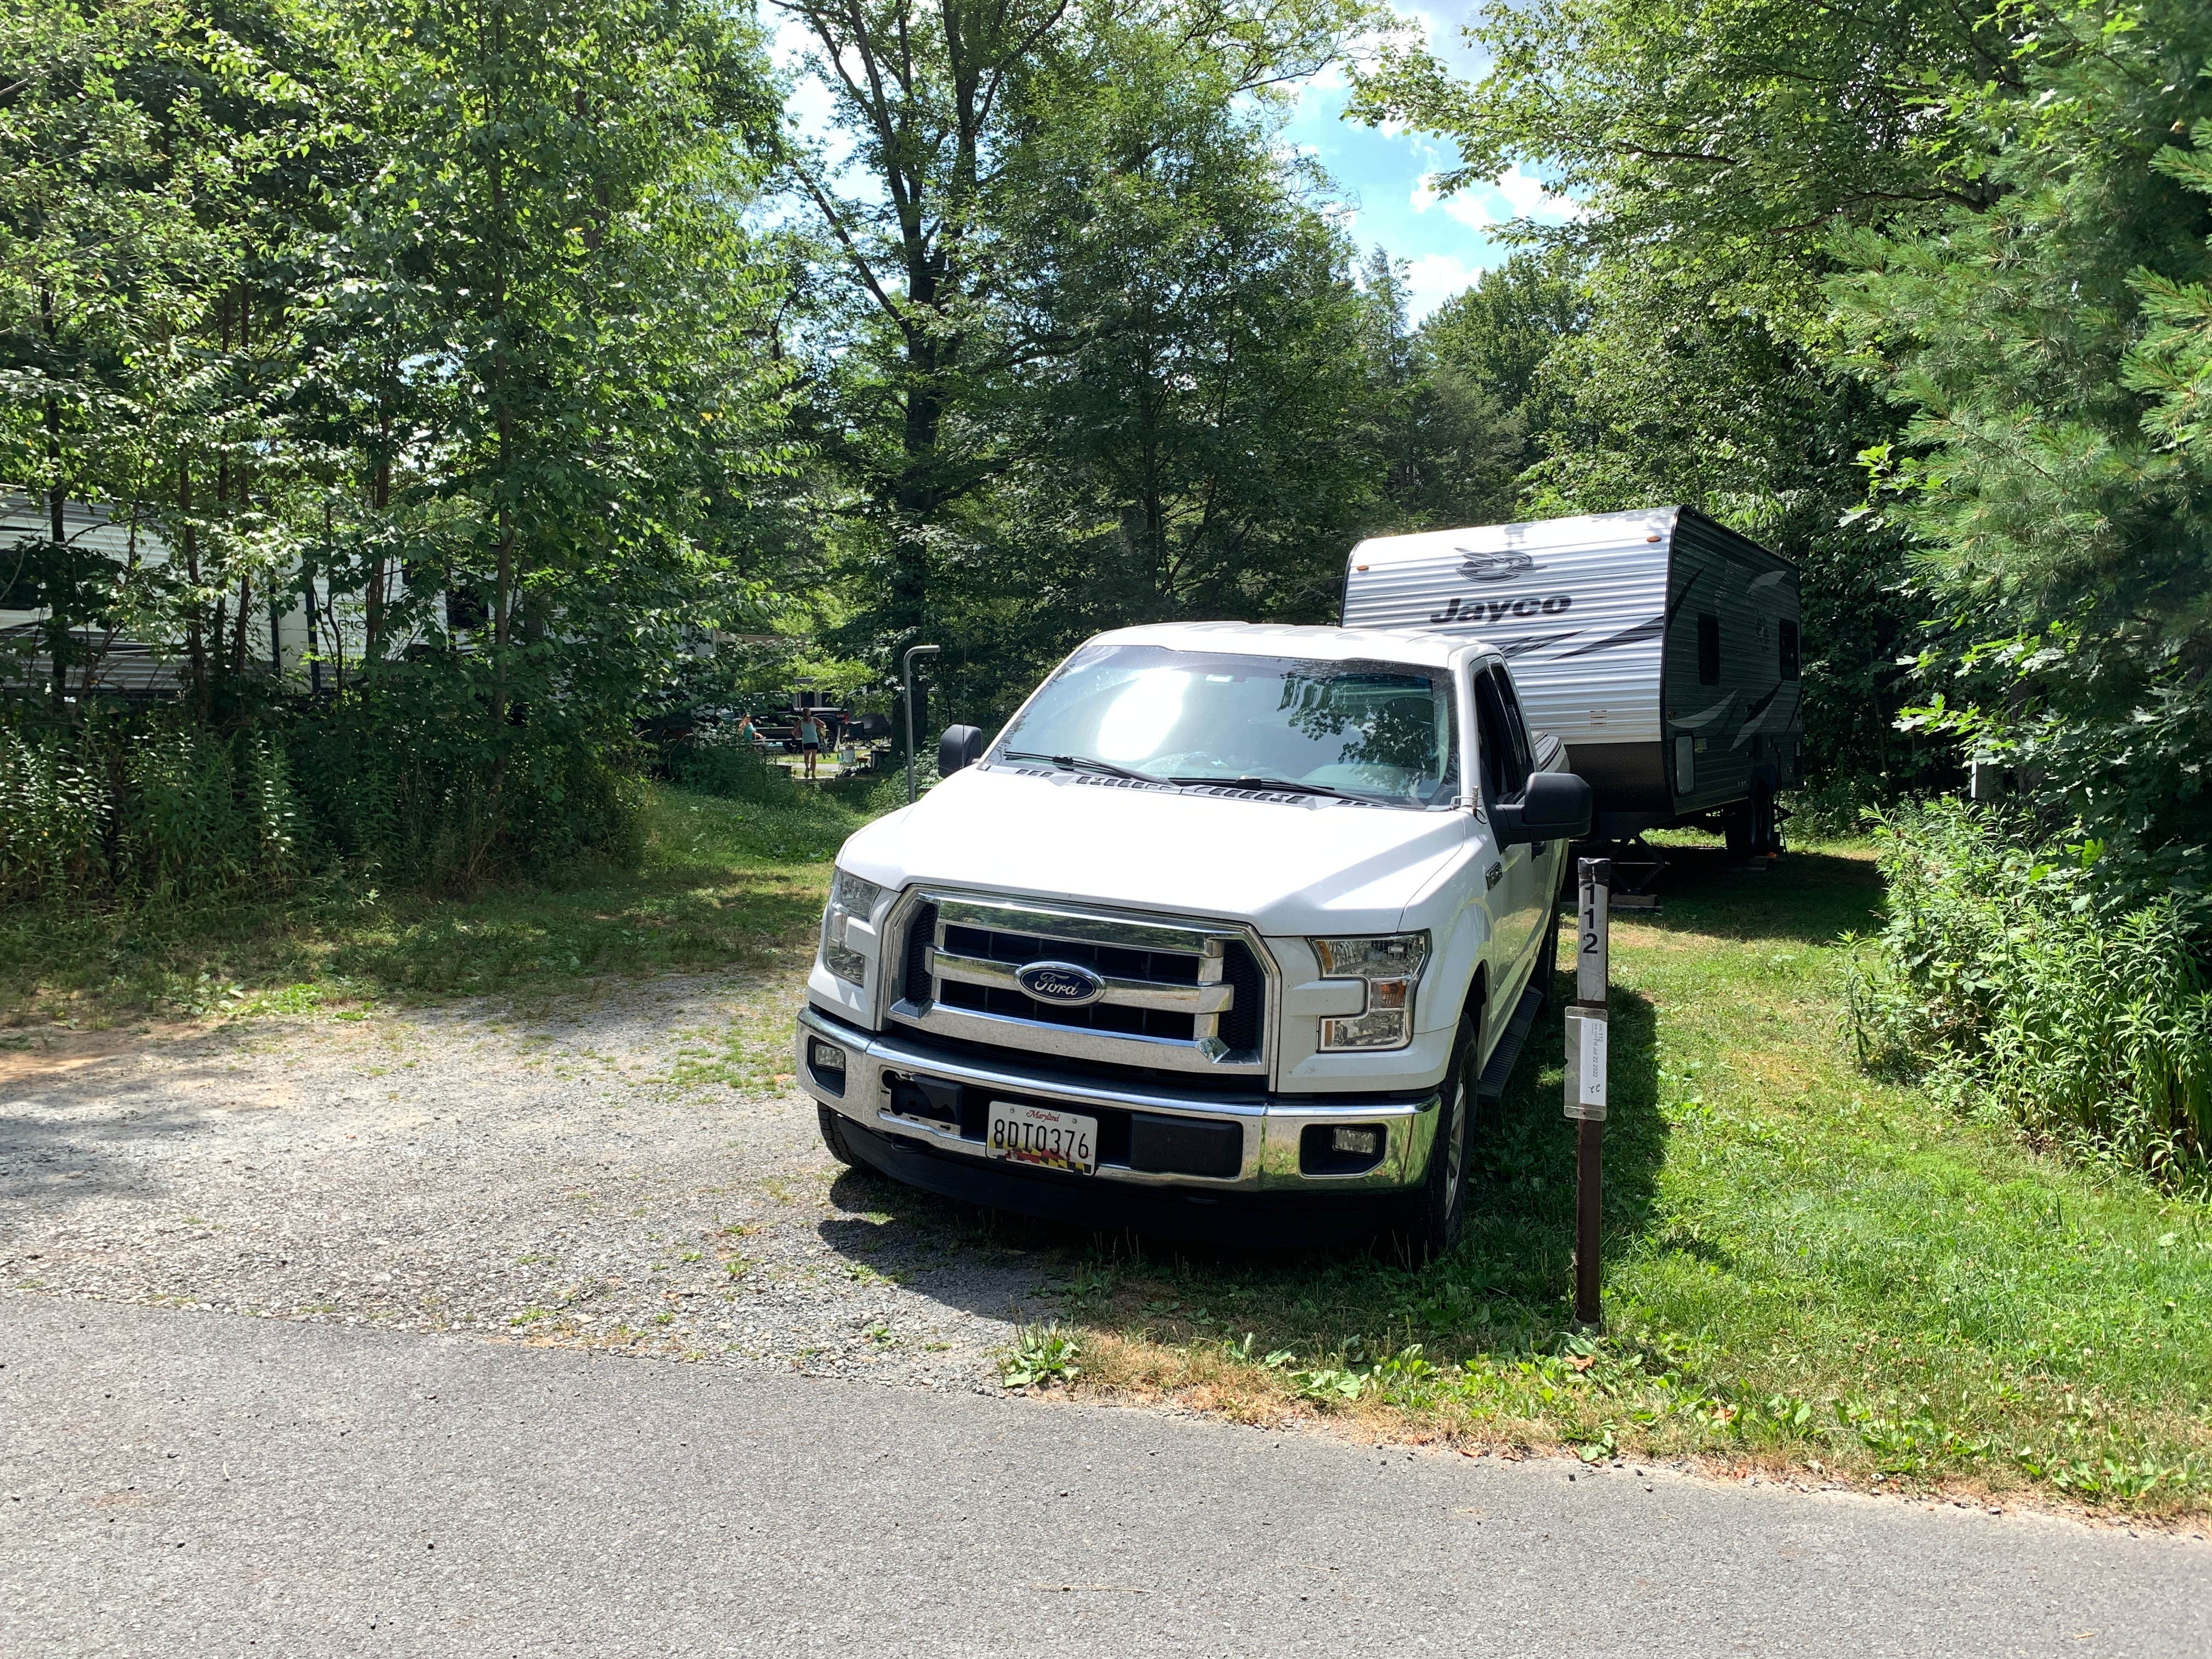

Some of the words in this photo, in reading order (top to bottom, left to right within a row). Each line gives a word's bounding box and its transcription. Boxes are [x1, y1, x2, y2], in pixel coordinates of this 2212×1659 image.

[1430, 595, 1572, 625] Jayco
[1034, 972, 1080, 996] Ford
[1026, 1109, 1060, 1122] Maryland
